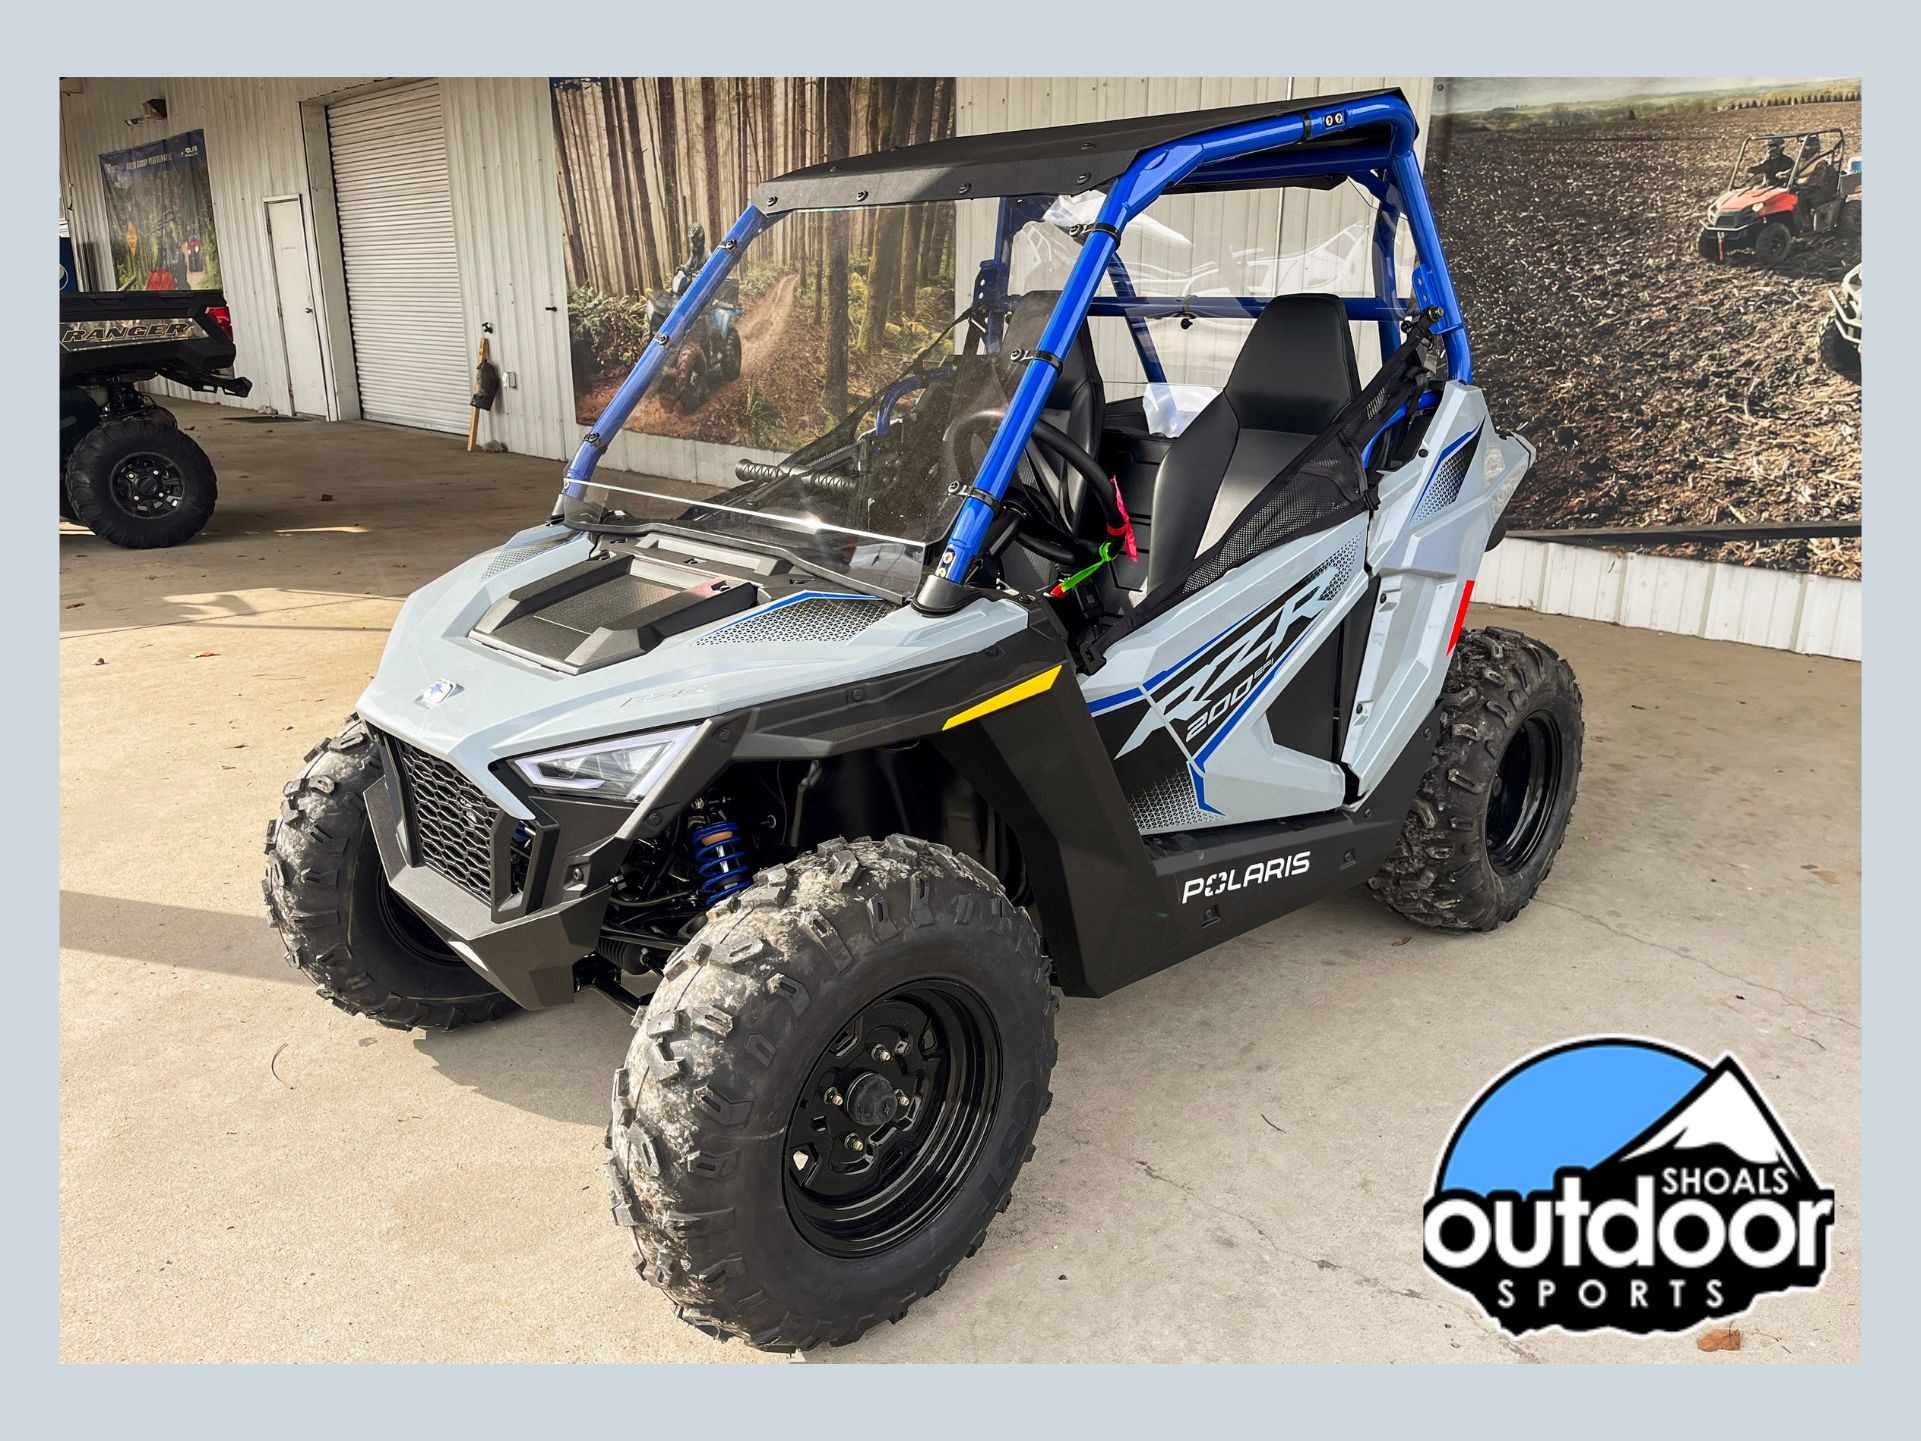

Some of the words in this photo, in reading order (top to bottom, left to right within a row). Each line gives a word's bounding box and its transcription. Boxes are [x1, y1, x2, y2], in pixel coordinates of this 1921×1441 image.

[62, 323, 189, 342] RANGER
[1113, 566, 1339, 760] RZR
[1185, 674, 1254, 743] 200
[1181, 850, 1311, 904] POLARIS
